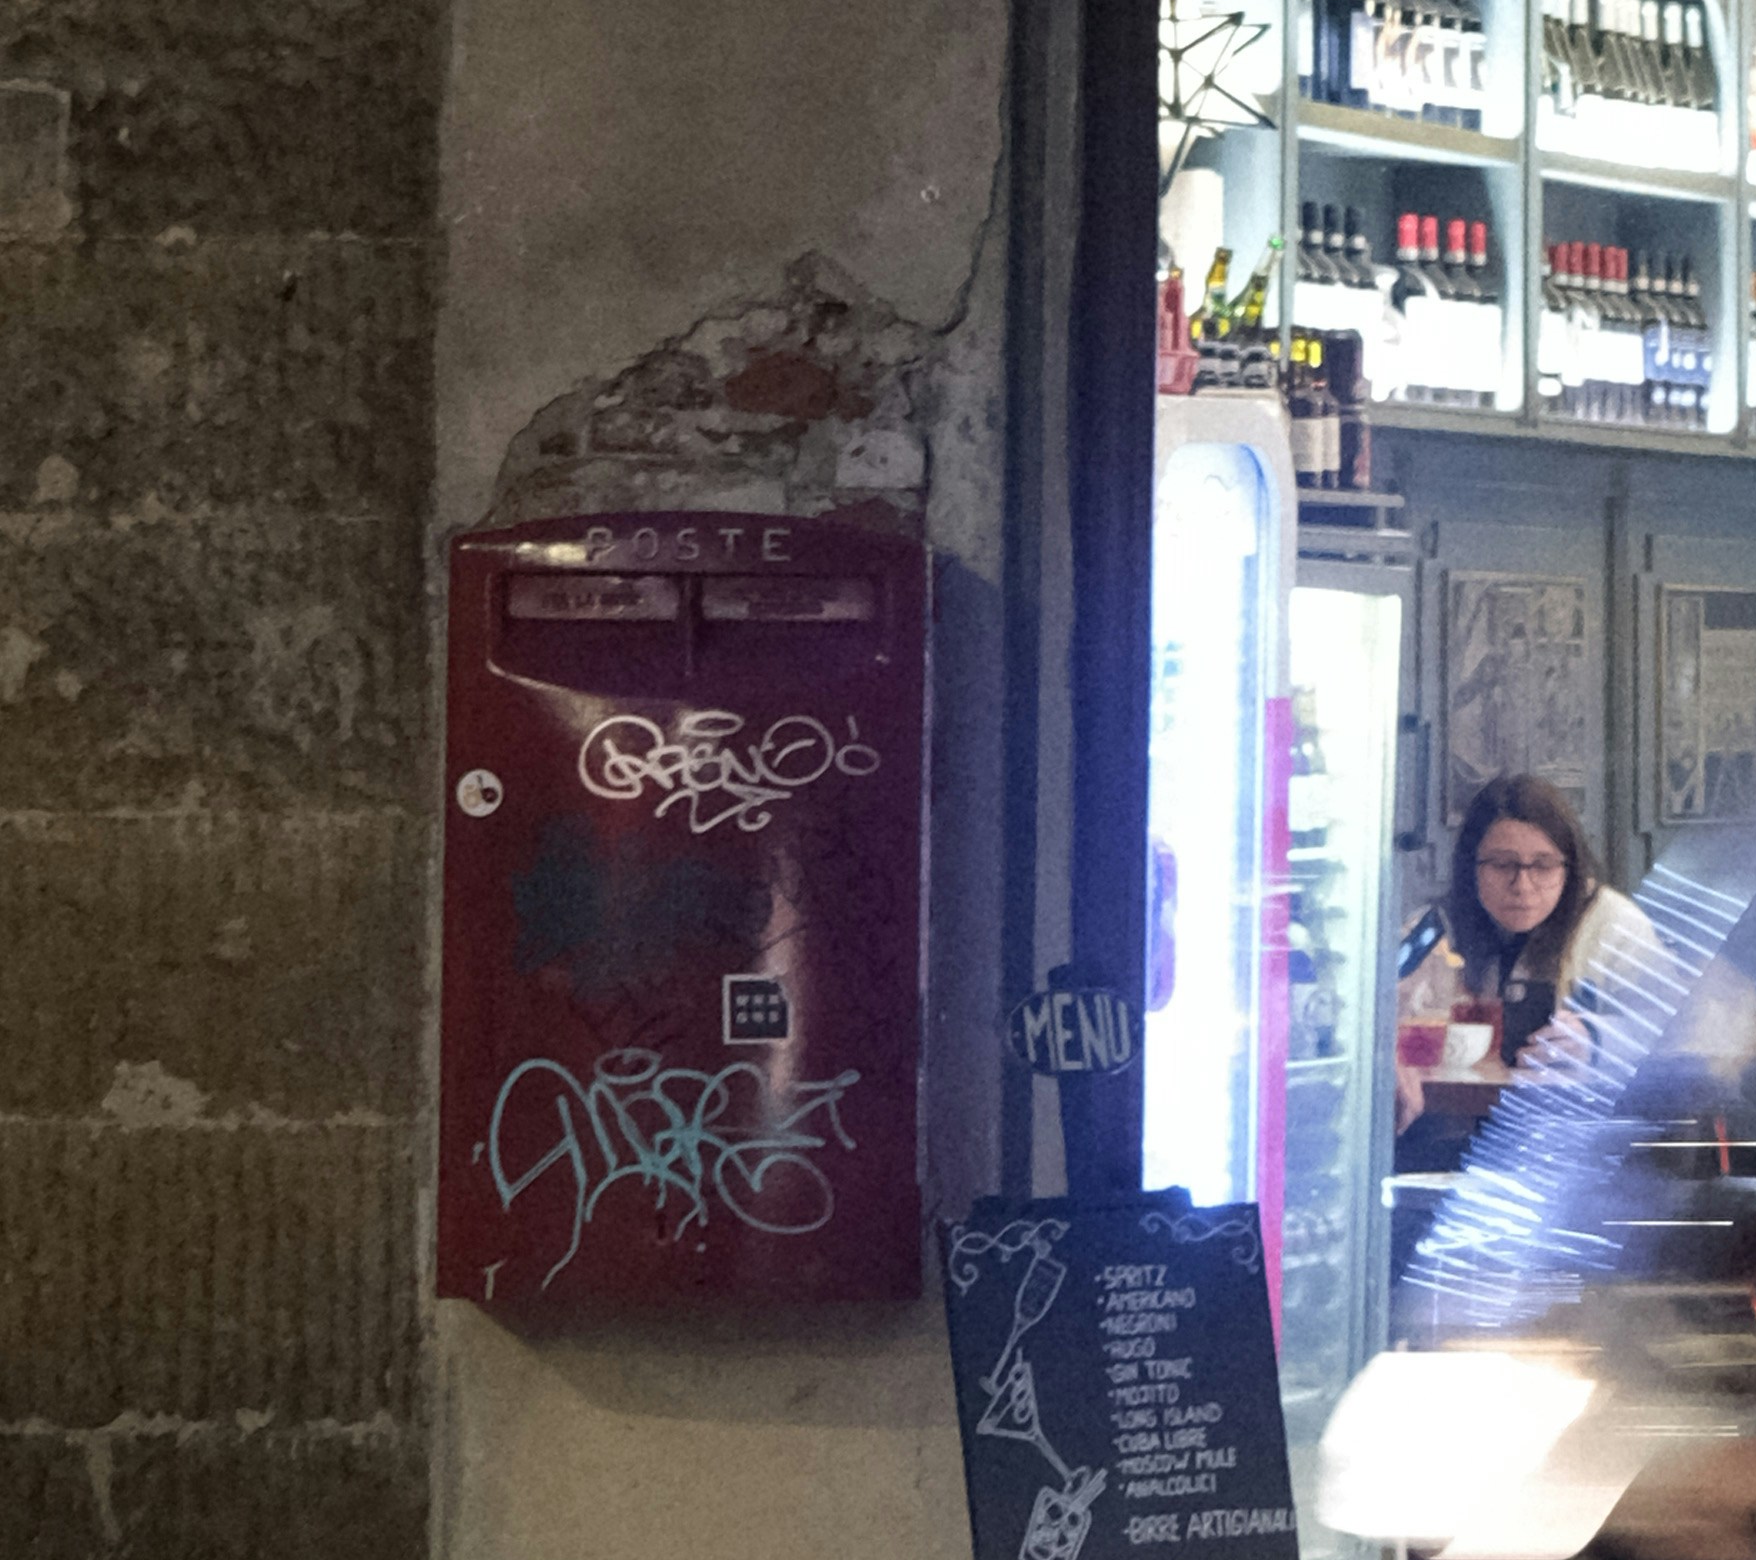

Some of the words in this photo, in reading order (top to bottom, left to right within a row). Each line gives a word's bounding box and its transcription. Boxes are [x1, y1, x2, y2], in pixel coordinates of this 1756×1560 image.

[586, 526, 792, 562] POSTE
[1023, 991, 1131, 1071] MENU
[1103, 1264, 1168, 1291] SPRITZ
[1105, 1287, 1196, 1313] AMERICANO
[1107, 1312, 1178, 1335] NEGRONI
[1114, 1382, 1181, 1406] MOJITO
[1116, 1408, 1157, 1430] LONG
[1163, 1401, 1223, 1427] ISLAND
[1117, 1432, 1161, 1454] CUBA
[1163, 1426, 1207, 1451] LIBRE
[1120, 1450, 1190, 1475] MOSCOW
[1195, 1446, 1237, 1469] MULE
[1124, 1473, 1216, 1498] ANALCOLICI
[1129, 1514, 1181, 1545] BIRRE
